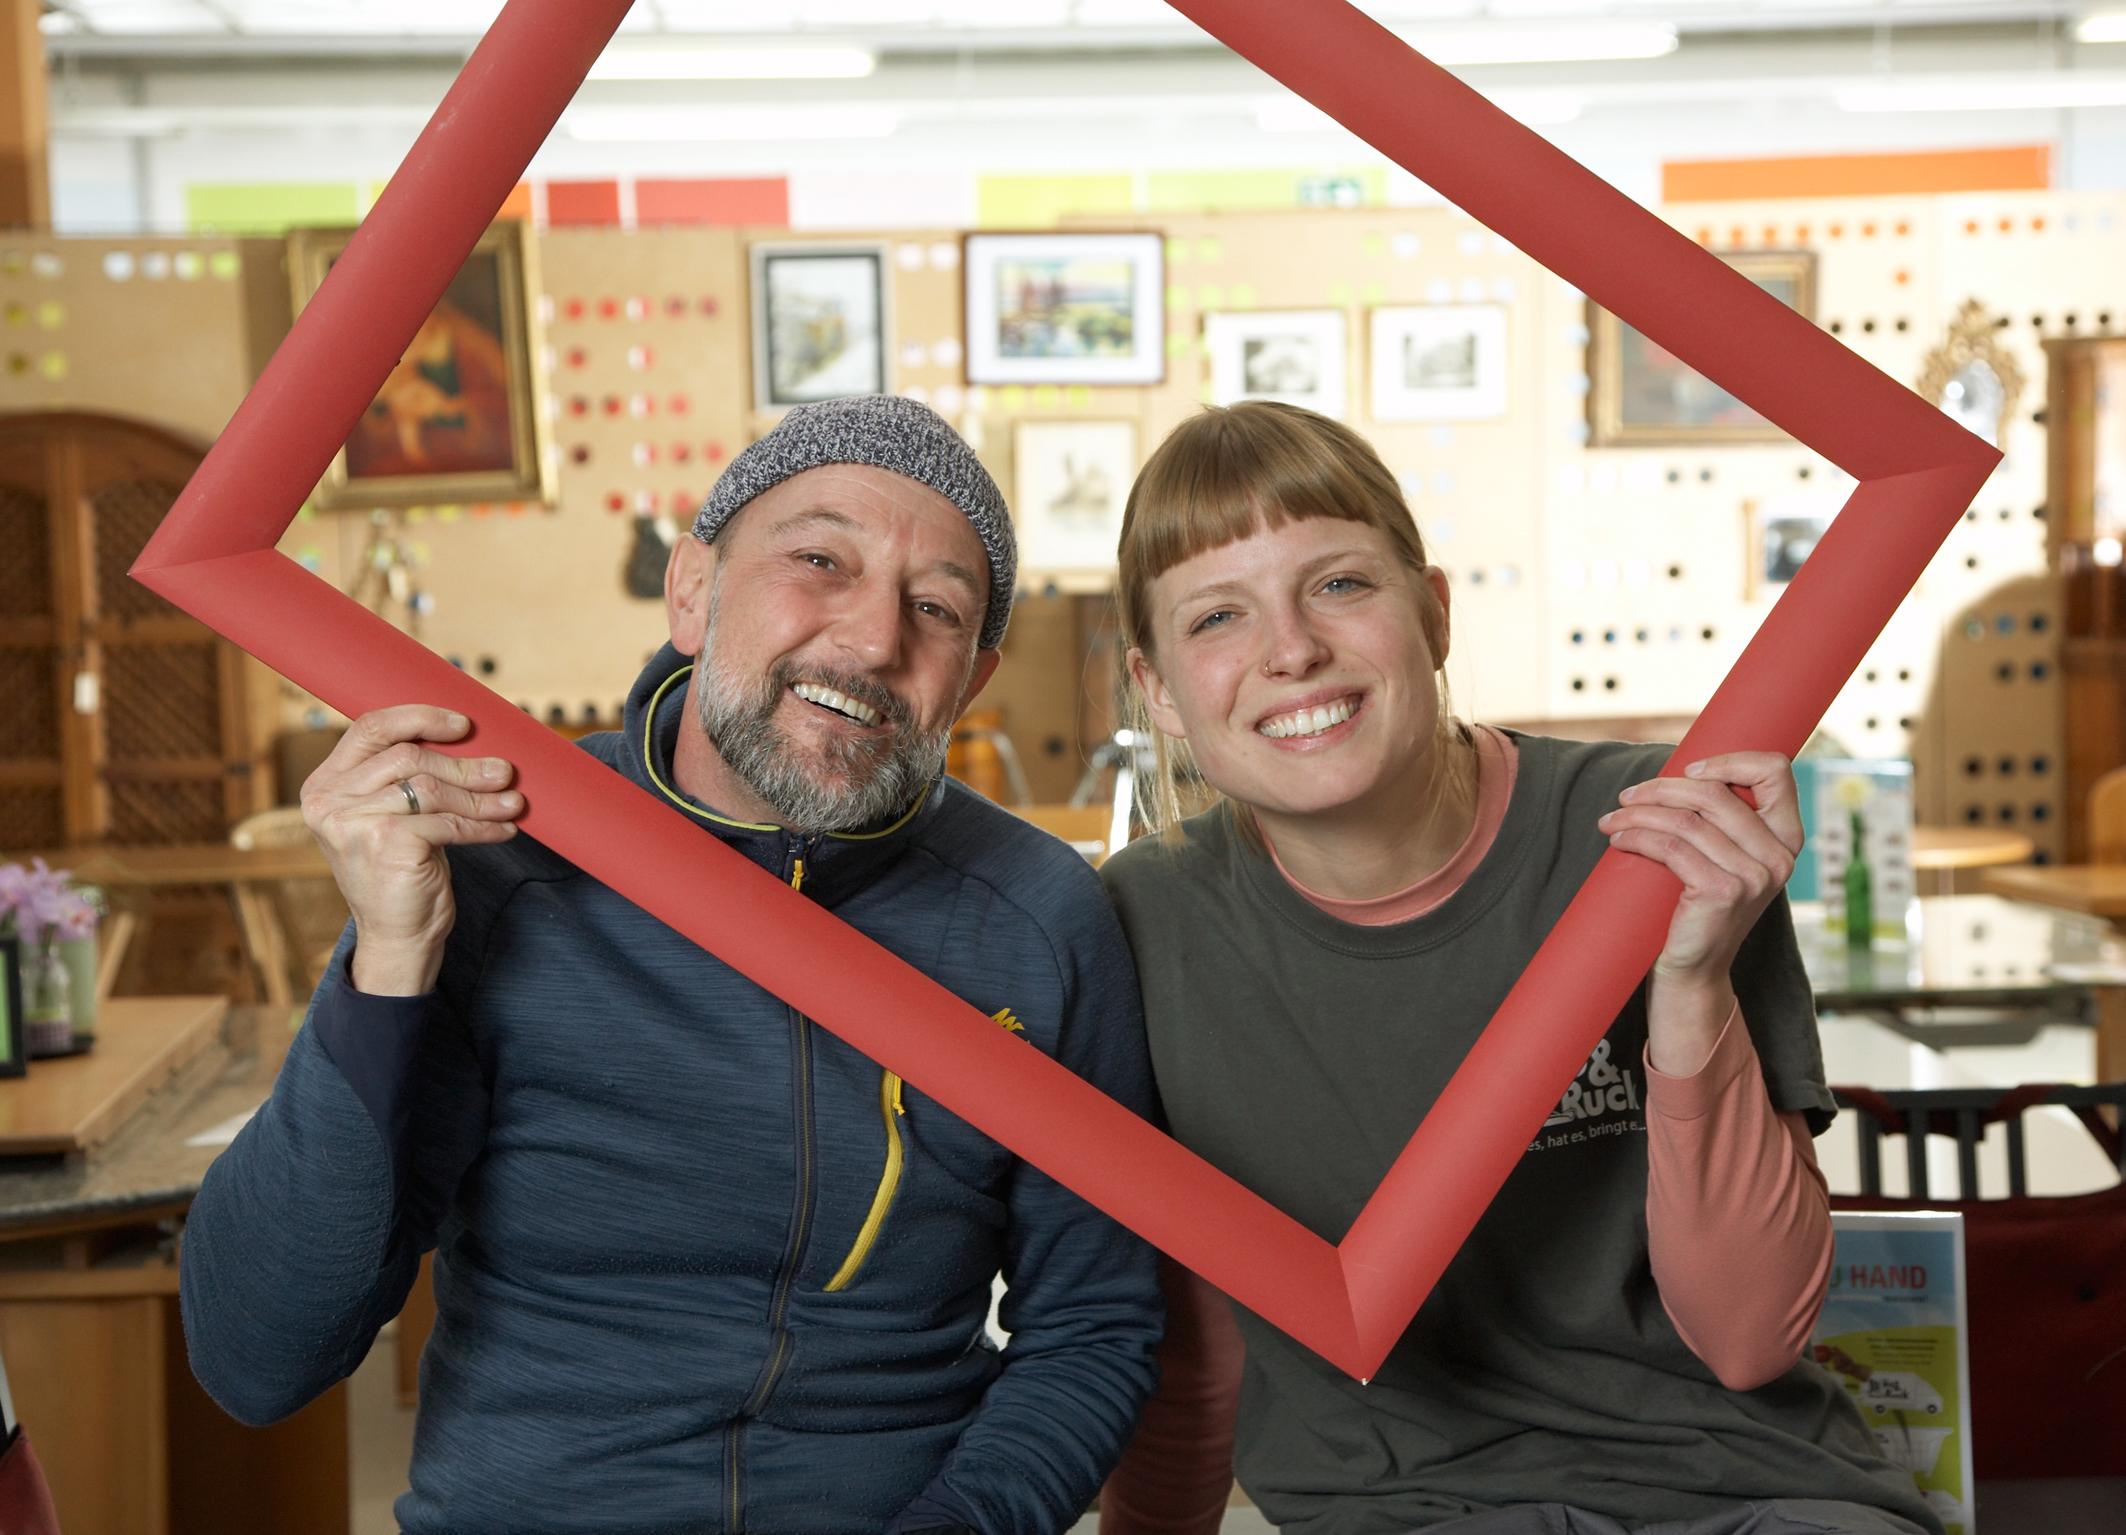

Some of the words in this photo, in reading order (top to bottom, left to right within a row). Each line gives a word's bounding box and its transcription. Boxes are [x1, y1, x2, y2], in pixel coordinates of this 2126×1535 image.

[1589, 1038, 1621, 1087] &
[1547, 1135, 1569, 1148] hat
[1588, 1120, 1628, 1138] bringt
[1850, 1264, 1927, 1289] HAND
